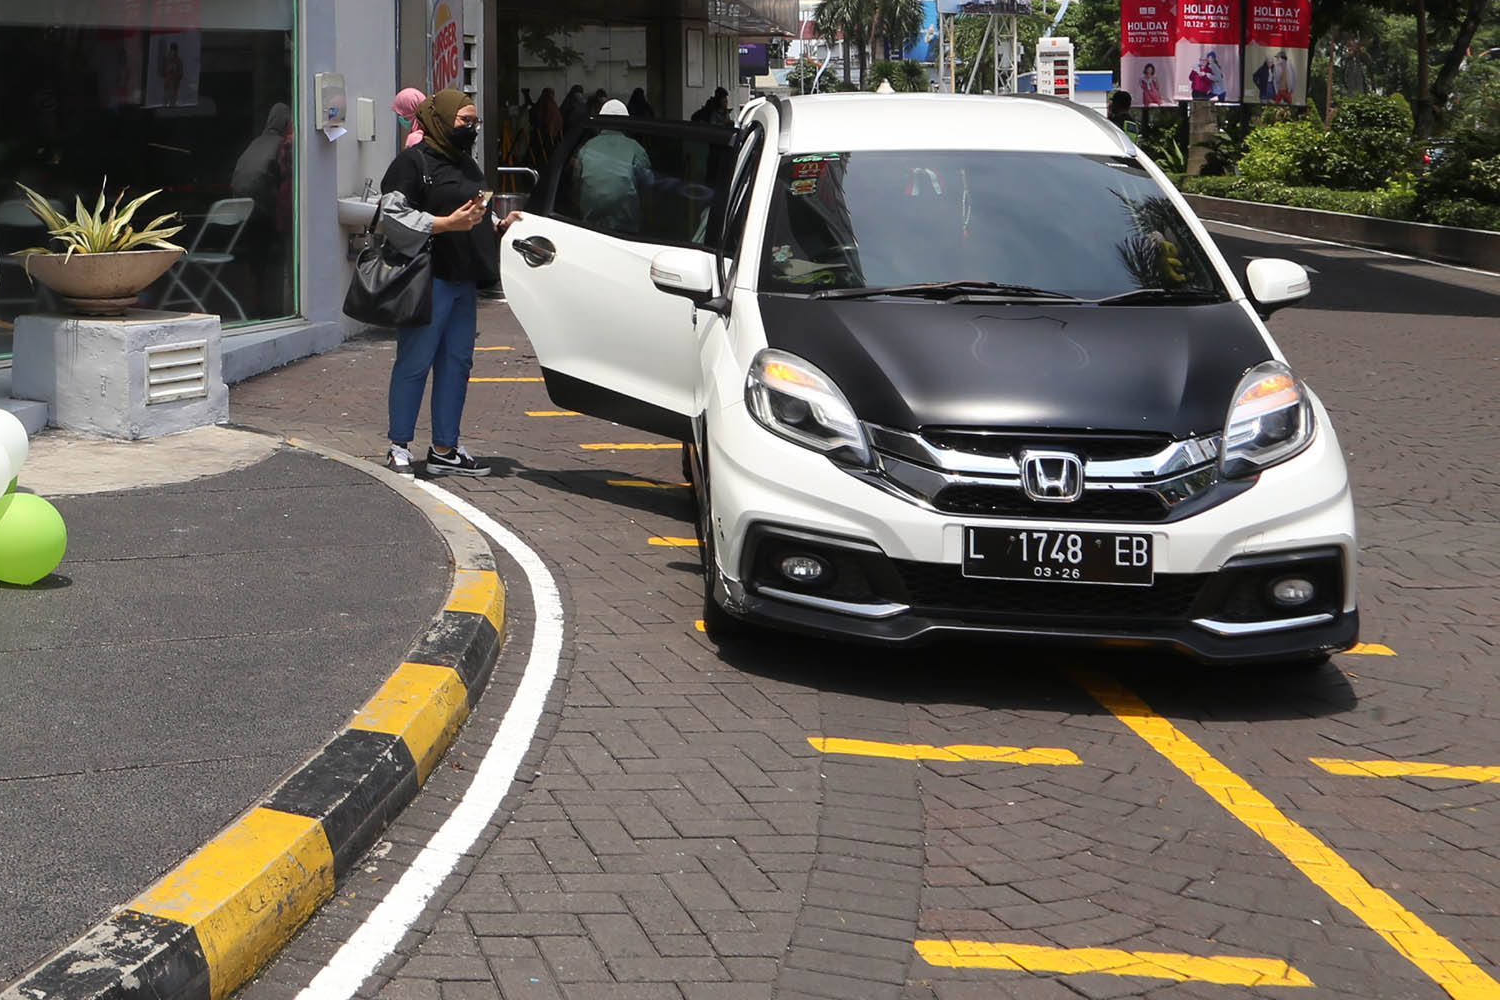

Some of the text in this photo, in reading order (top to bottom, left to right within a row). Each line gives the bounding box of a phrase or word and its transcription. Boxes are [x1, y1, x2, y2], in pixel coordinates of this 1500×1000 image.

[1183, 3, 1230, 15] HOLIDAY
[1253, 6, 1301, 18] HOLIDAY
[1127, 20, 1168, 31] HOLIDAY
[969, 529, 1148, 567] L 1748 EB
